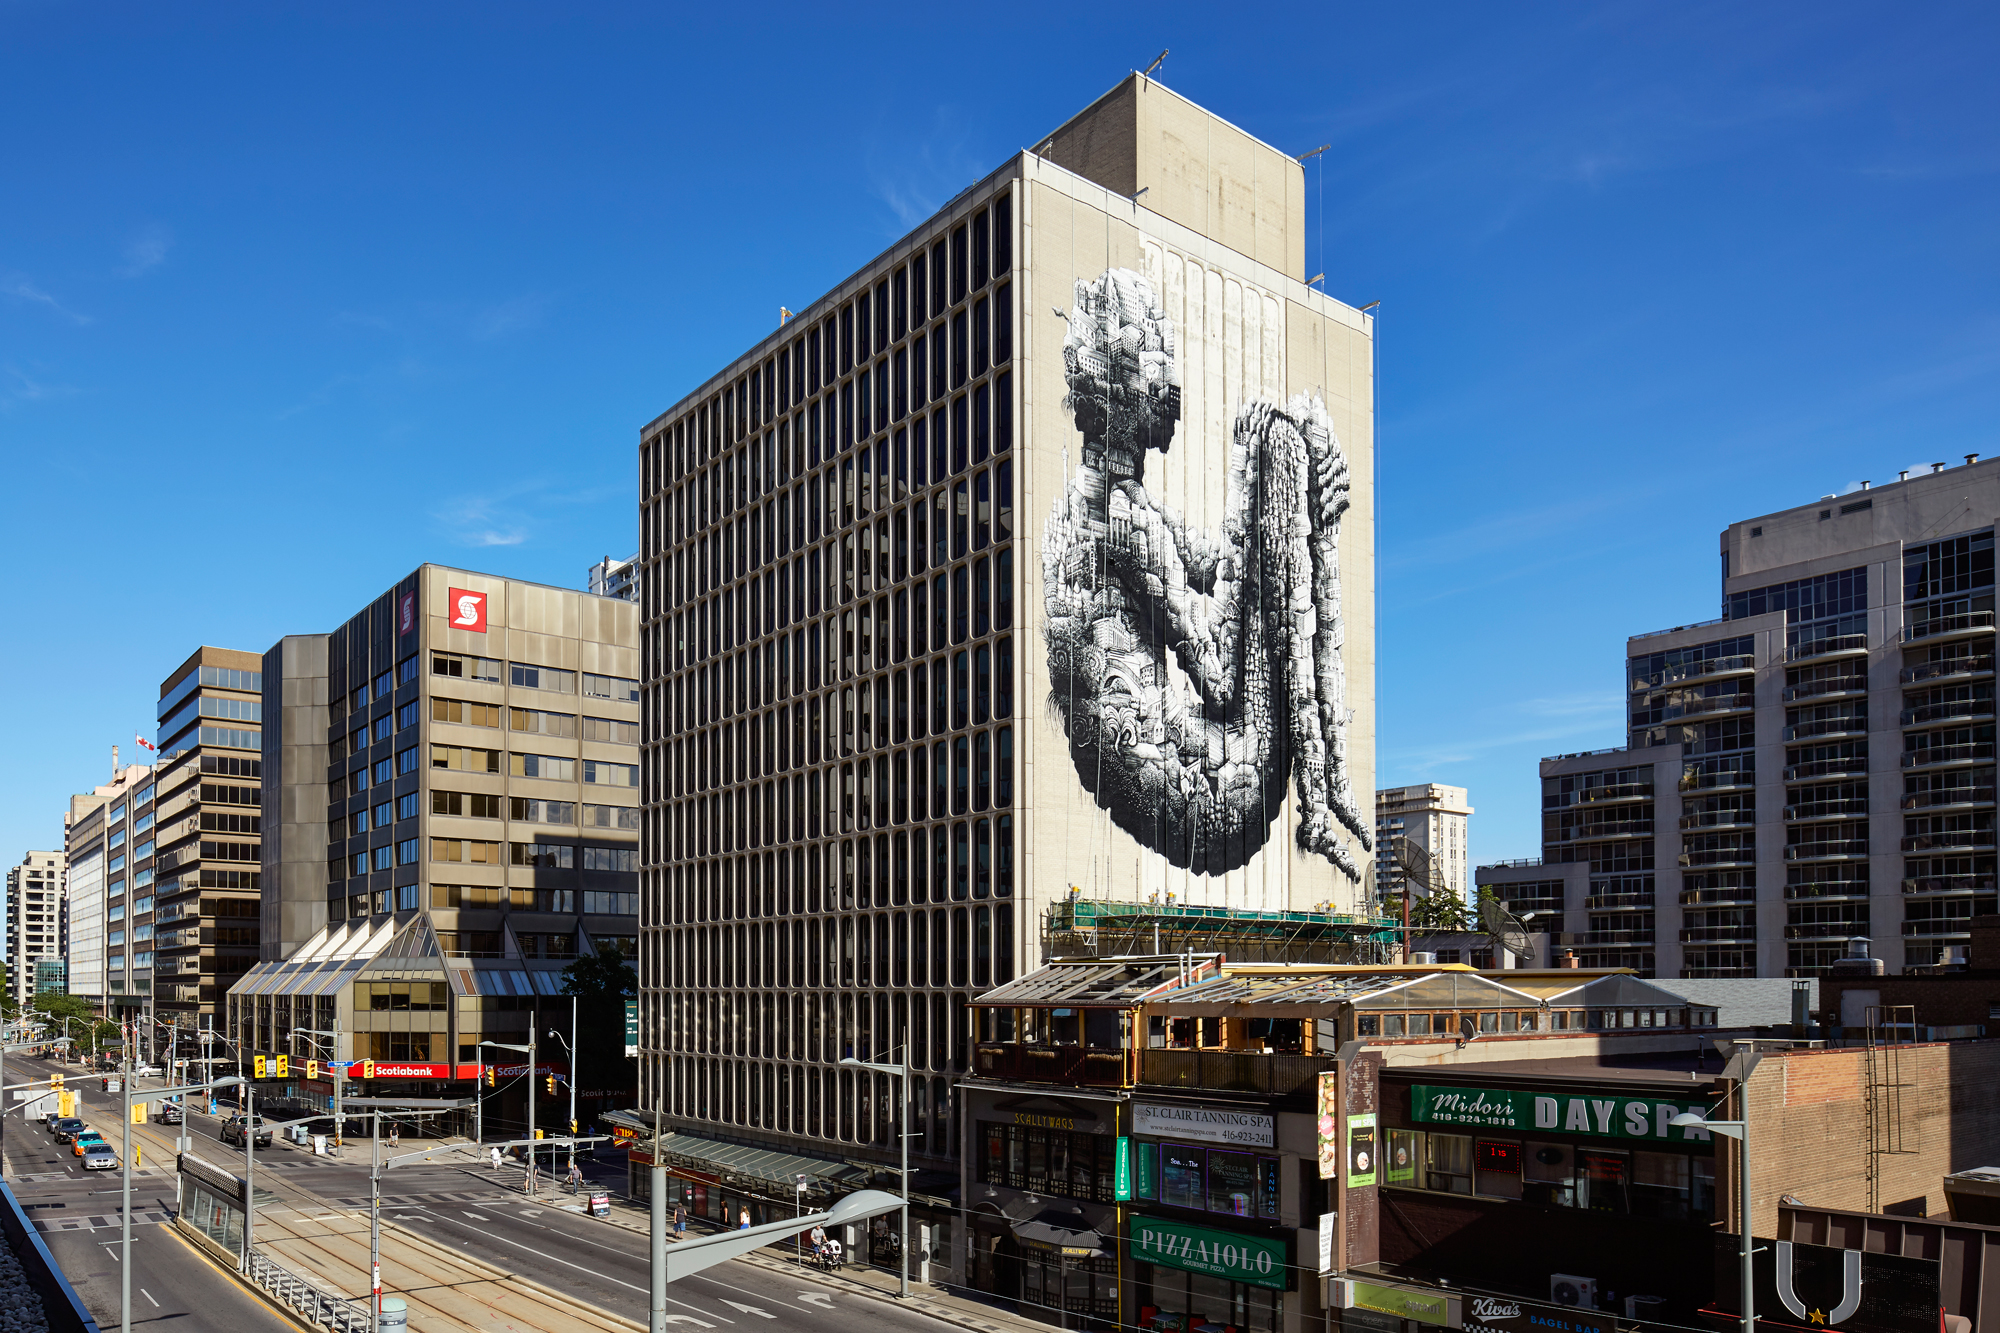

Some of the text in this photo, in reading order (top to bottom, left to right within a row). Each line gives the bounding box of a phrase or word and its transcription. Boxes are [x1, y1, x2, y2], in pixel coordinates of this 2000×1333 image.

[376, 1066, 432, 1076] Scotiabank
[1431, 1092, 1514, 1116] Midori
[1145, 1106, 1272, 1129] ST. CLAIR TANNING SPA
[1431, 1112, 1515, 1127] 416-924-1818
[1534, 1096, 1711, 1141] DAY SPA
[1221, 1129, 1272, 1144] 416-923-2411
[1142, 1228, 1272, 1274] PIZZAIOLO
[1182, 1258, 1226, 1273] GOURMET PIZZA
[1405, 1300, 1441, 1315] sprout
[1471, 1297, 1521, 1317] Kiva's
[1530, 1315, 1570, 1331] BAGEL
